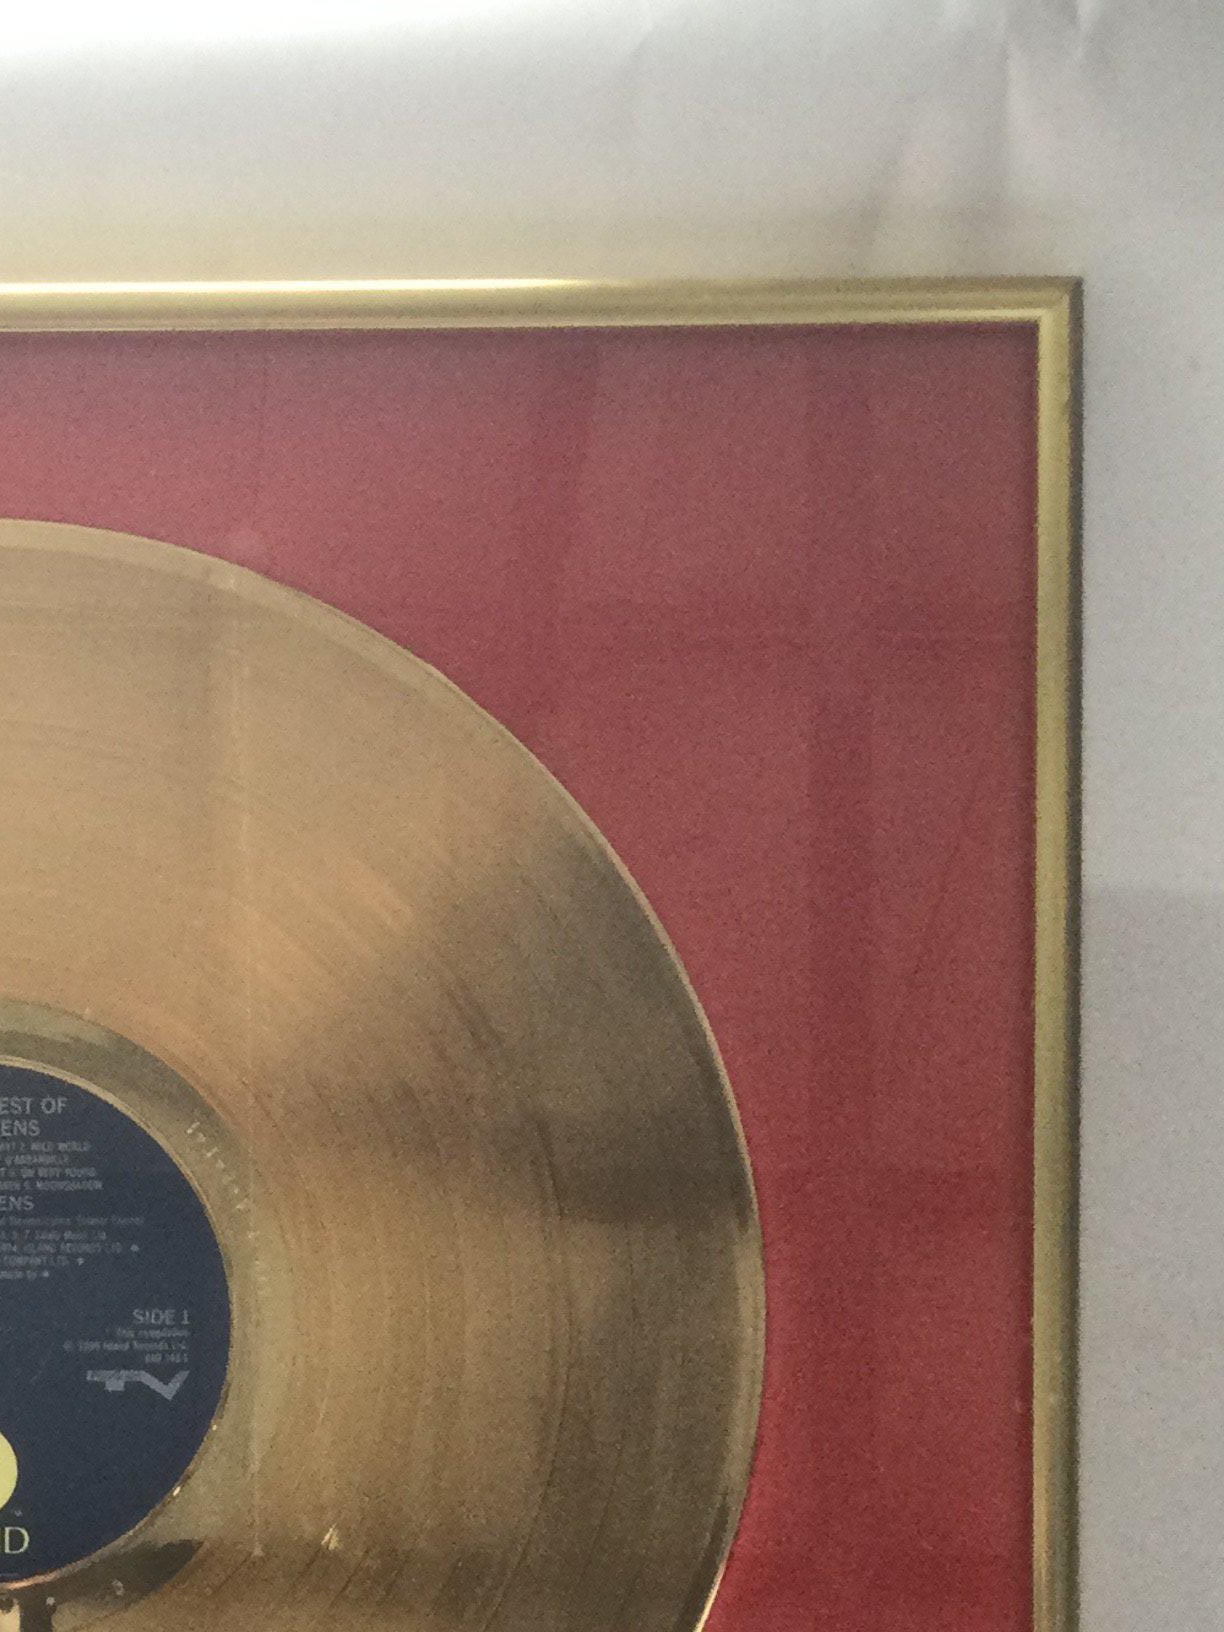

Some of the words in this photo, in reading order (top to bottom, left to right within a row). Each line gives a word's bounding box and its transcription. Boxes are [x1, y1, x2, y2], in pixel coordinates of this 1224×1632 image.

[40, 1097, 68, 1116] OF
[133, 1308, 176, 1325] SIDE
[181, 1308, 190, 1325] 1
